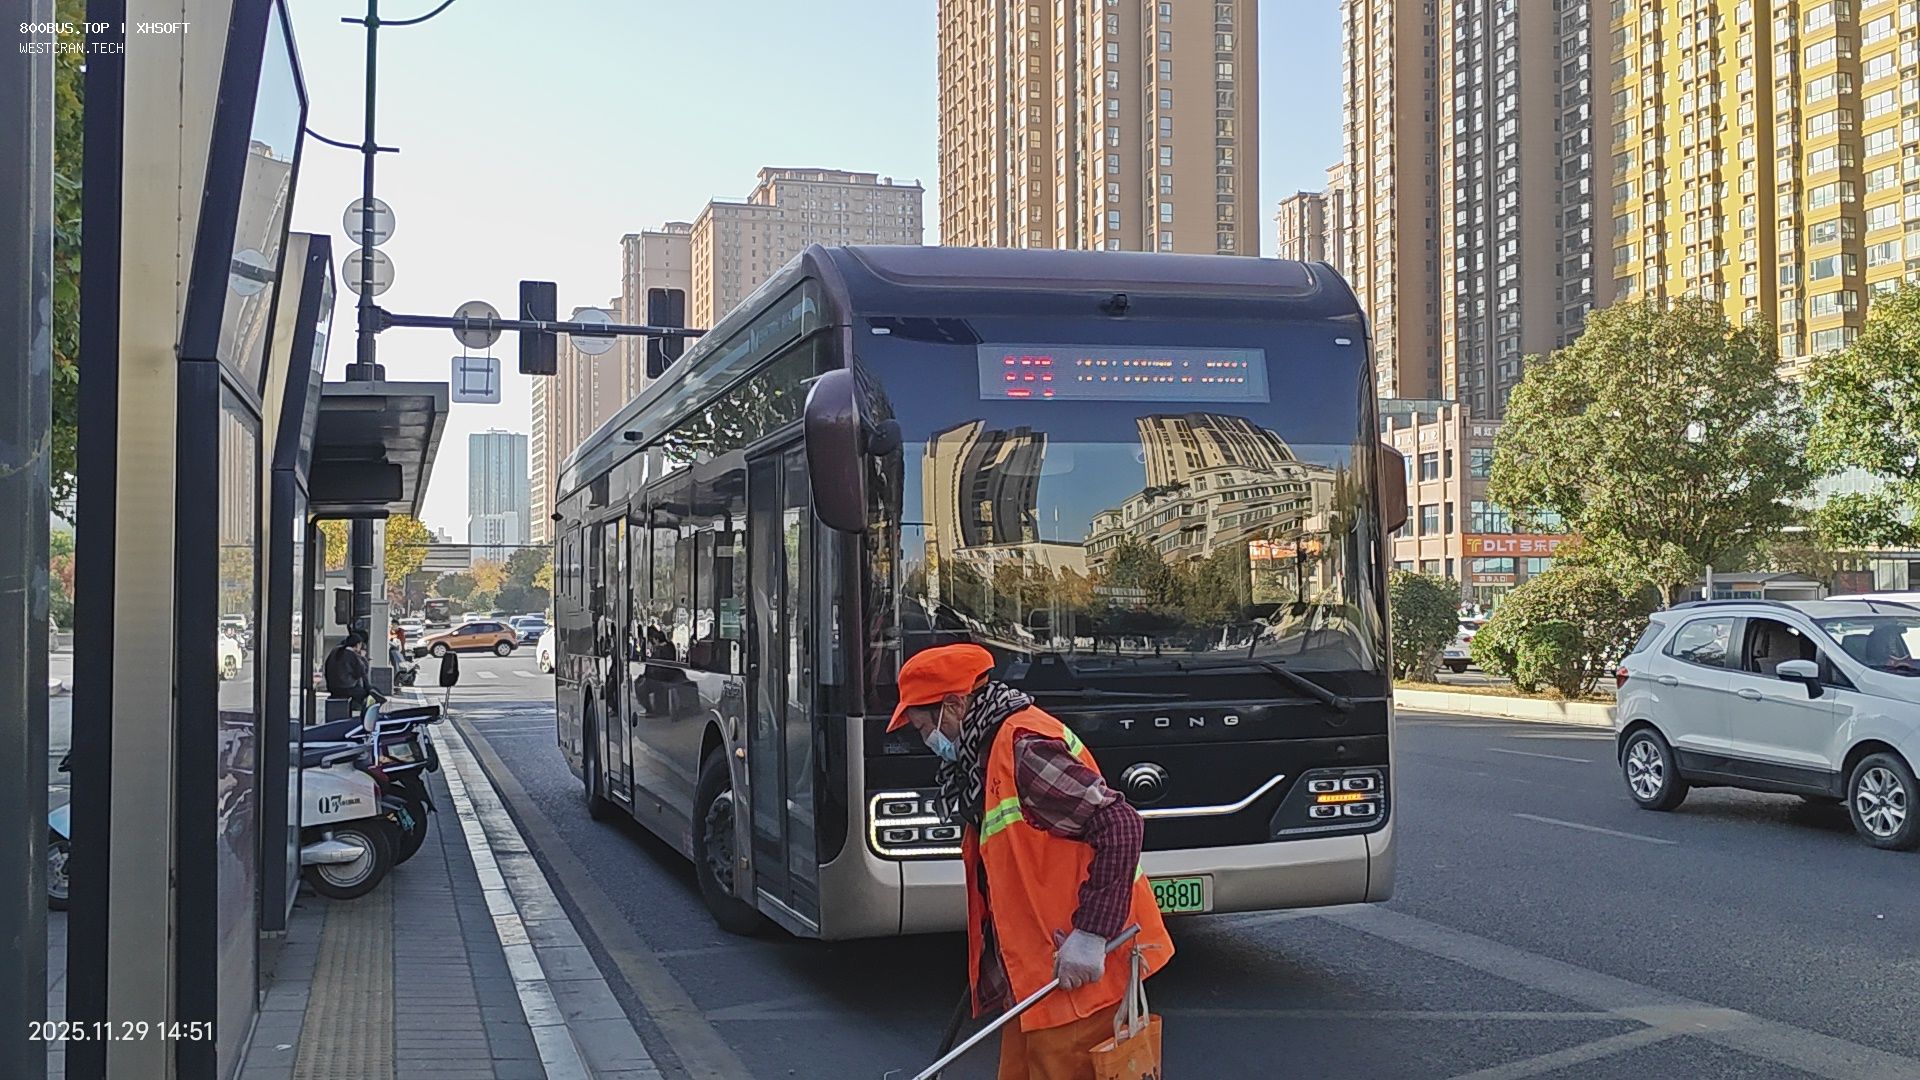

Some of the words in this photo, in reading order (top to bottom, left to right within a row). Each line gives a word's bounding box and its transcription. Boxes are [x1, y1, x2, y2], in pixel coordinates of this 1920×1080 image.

[1483, 539, 1517, 551] DLT
[1119, 715, 1239, 730] TONG
[1154, 882, 1201, 909] 888D
